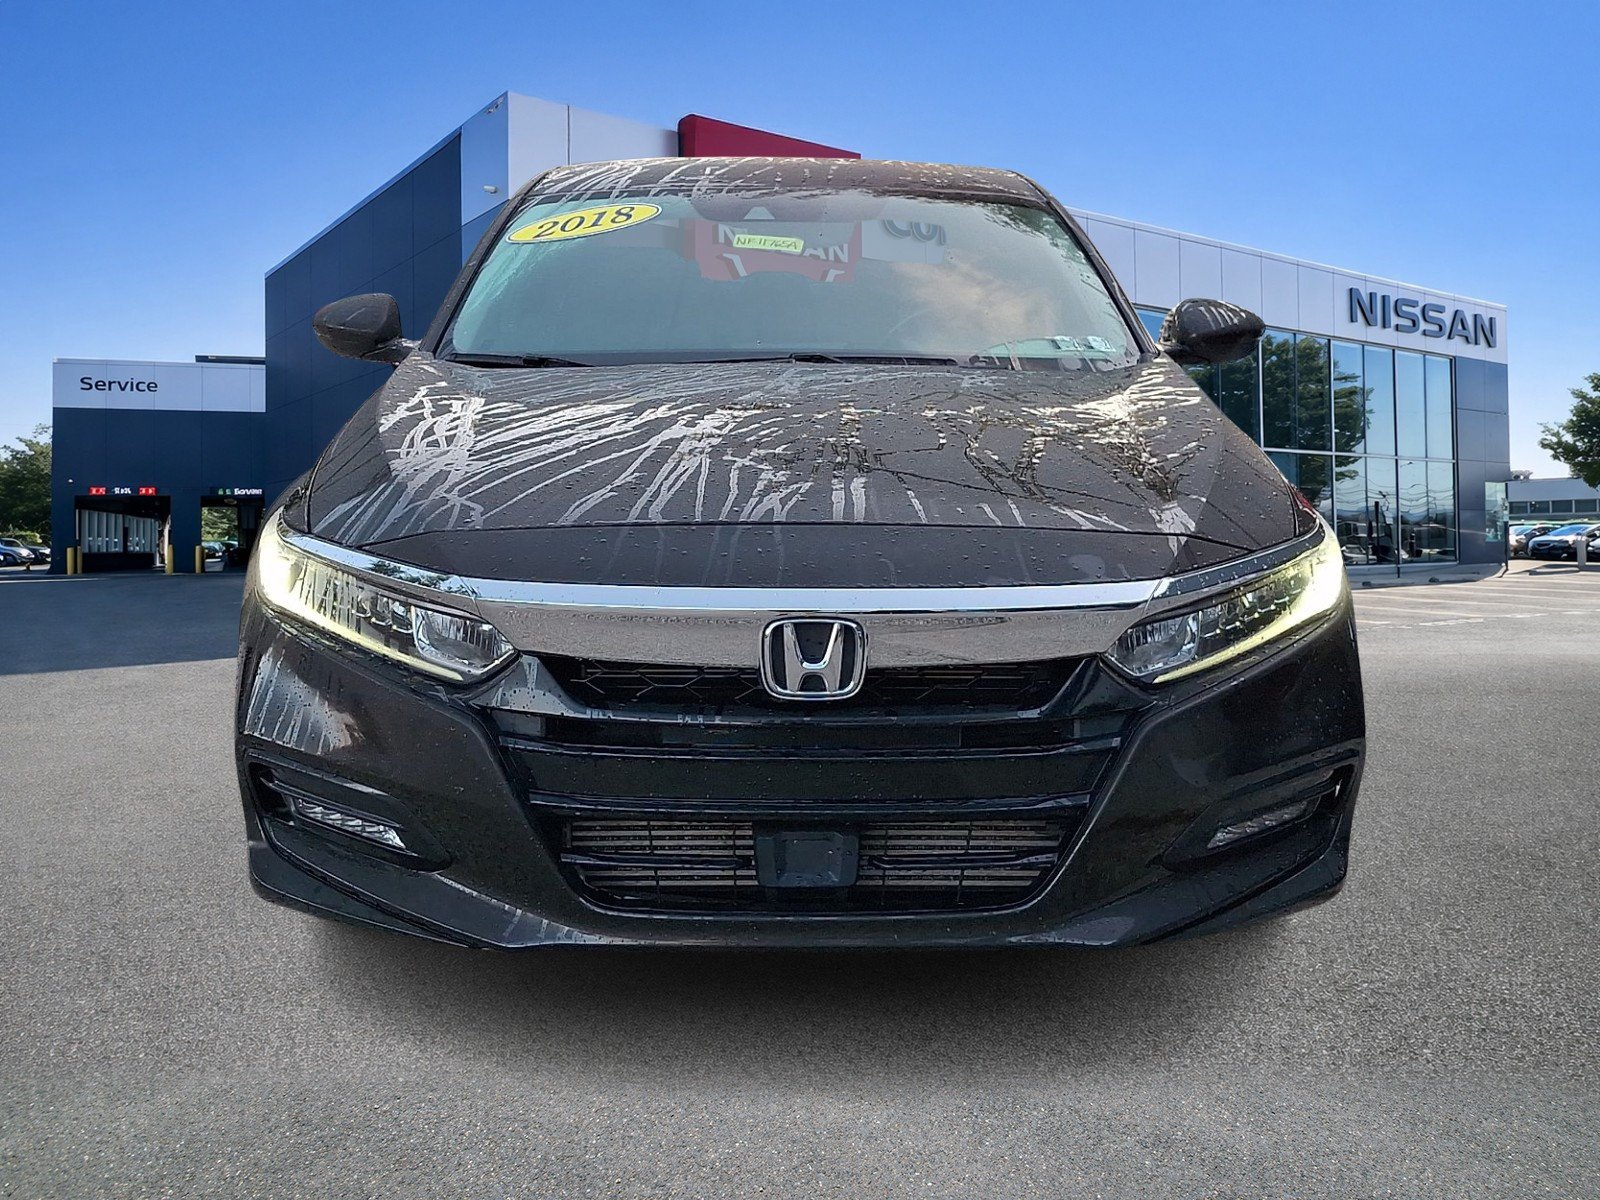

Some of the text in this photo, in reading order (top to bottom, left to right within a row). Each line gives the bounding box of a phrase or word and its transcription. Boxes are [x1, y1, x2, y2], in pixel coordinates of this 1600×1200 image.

[532, 206, 635, 239] 2018
[1349, 287, 1497, 348] NISSAN
[80, 376, 158, 393] Service
